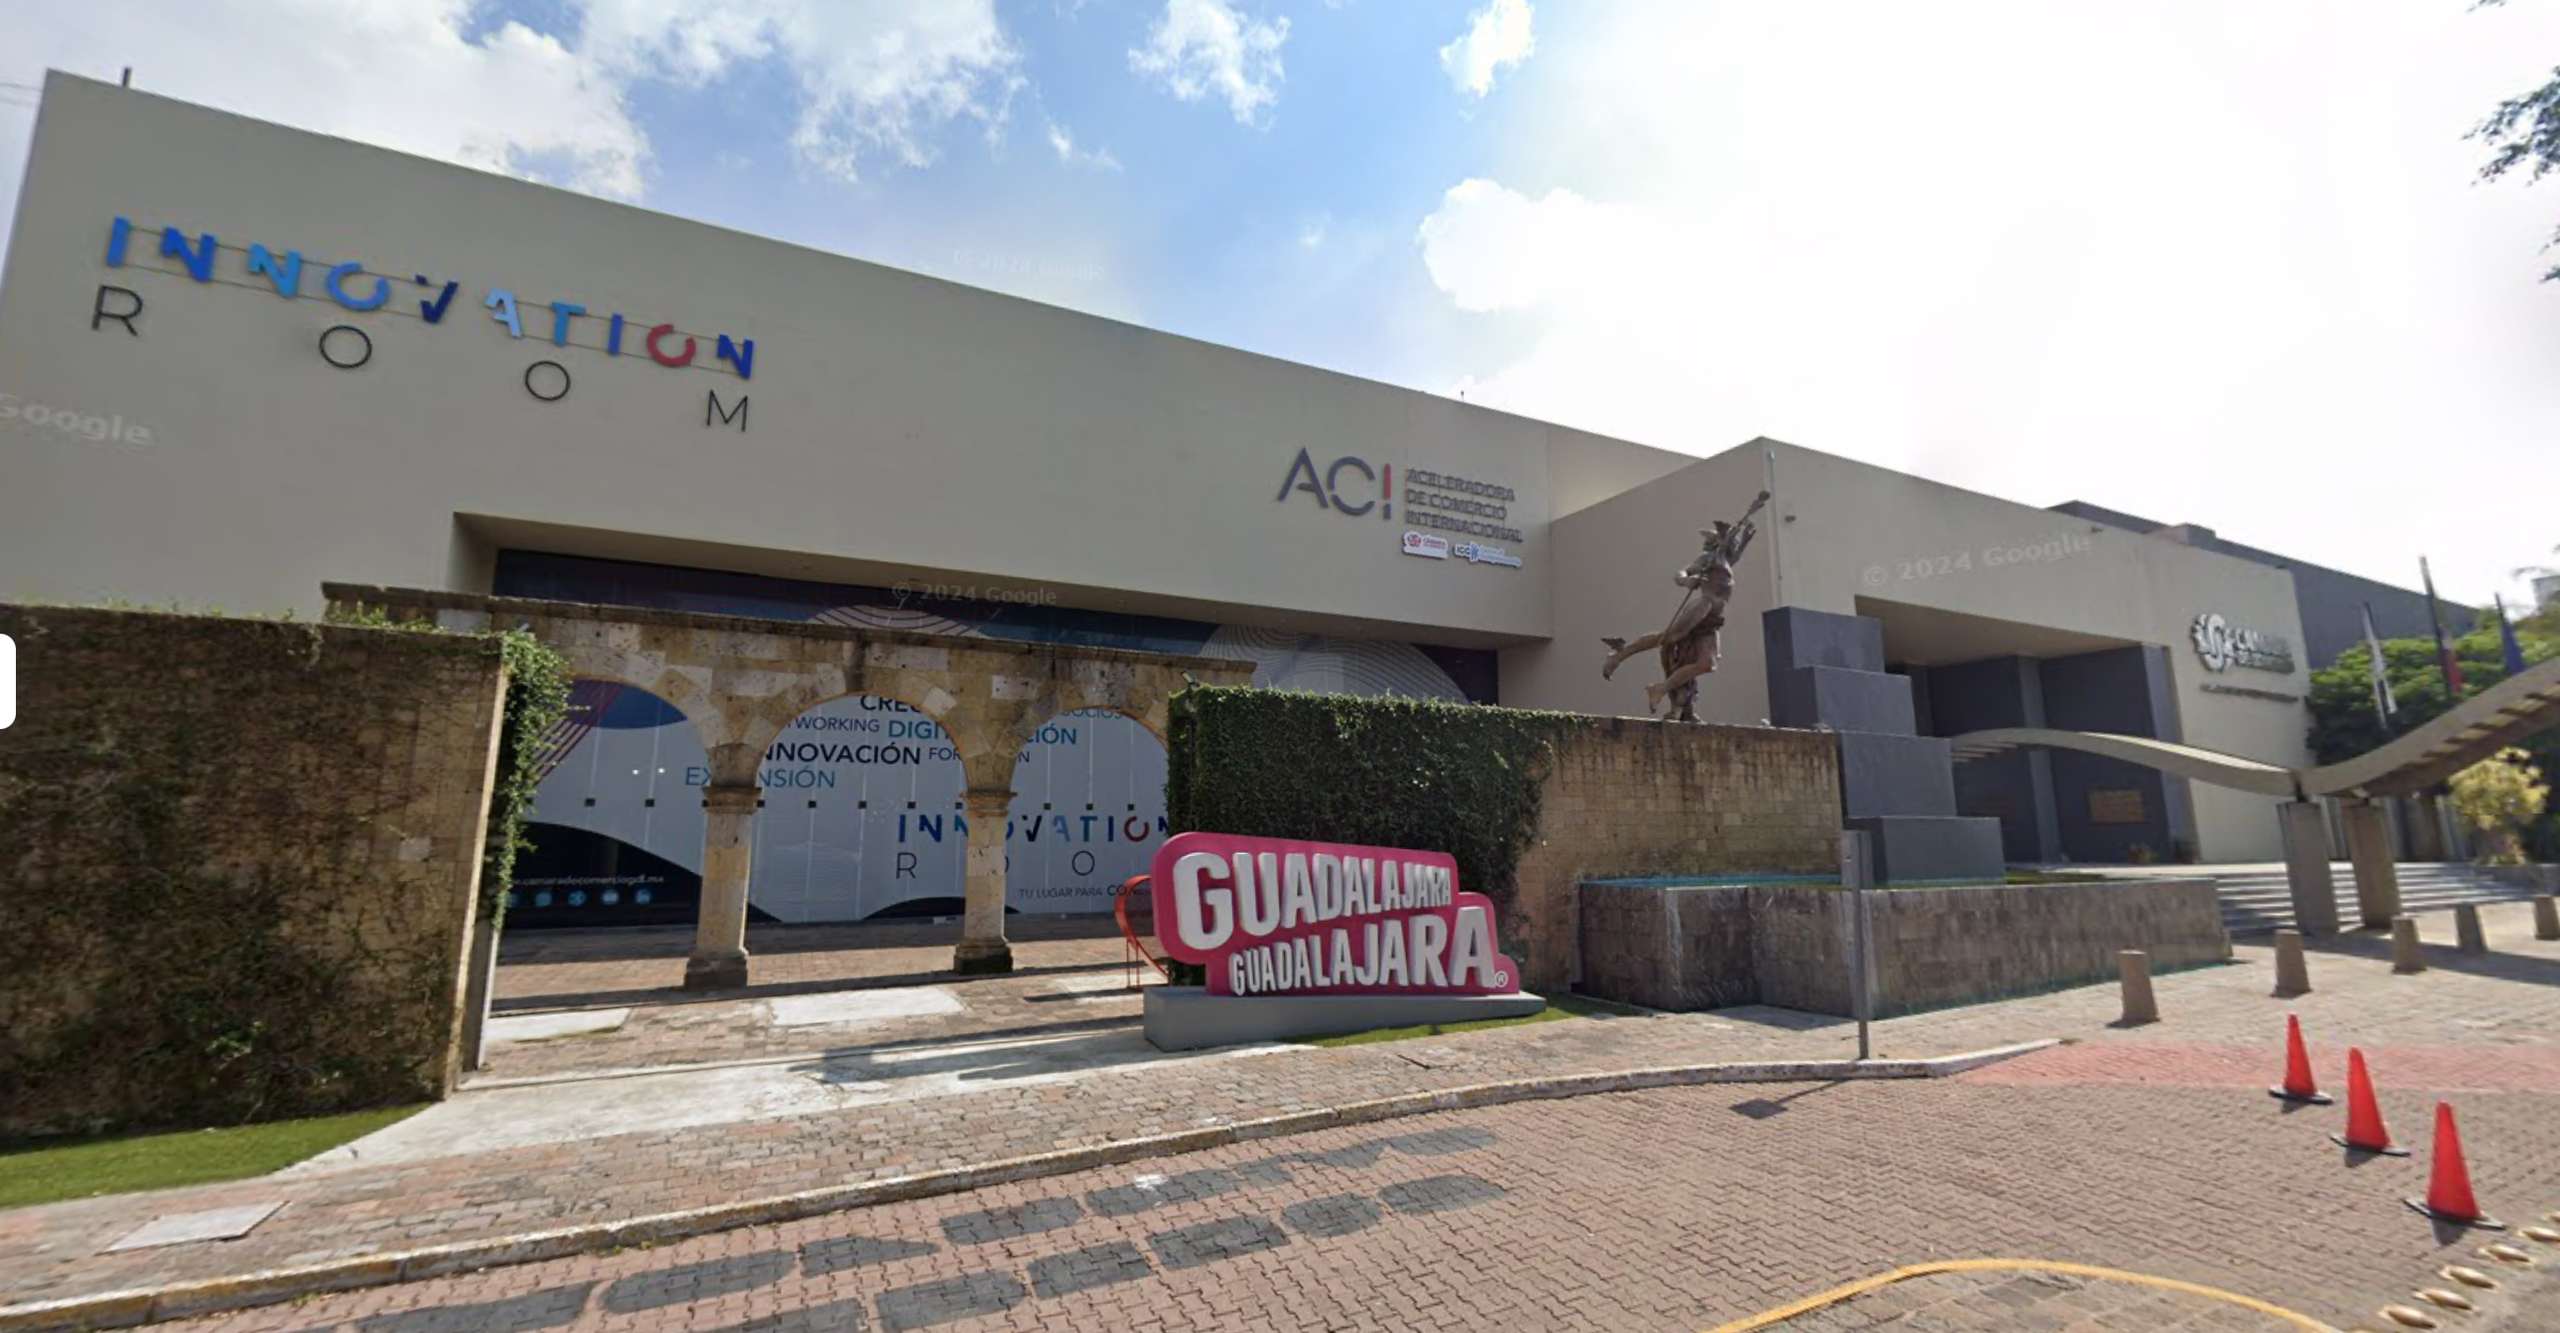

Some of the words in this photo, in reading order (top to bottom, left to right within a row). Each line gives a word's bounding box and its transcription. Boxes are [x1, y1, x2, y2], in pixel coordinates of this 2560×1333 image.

[106, 216, 754, 380] INNOVATION
[1406, 468, 1516, 502] ACELERADORA
[1406, 488, 1426, 506] DE
[1429, 493, 1507, 521] COMERCIO
[1406, 510, 1523, 542] INTERNACIONAL
[765, 742, 920, 765] NNOVACIÓN
[1019, 888, 1034, 899] TU
[1036, 887, 1072, 898] LUGAR
[1074, 886, 1103, 896] PARA
[1172, 851, 1452, 951] GUADALAJARA
[1228, 906, 1497, 996] GUADALAJARA
